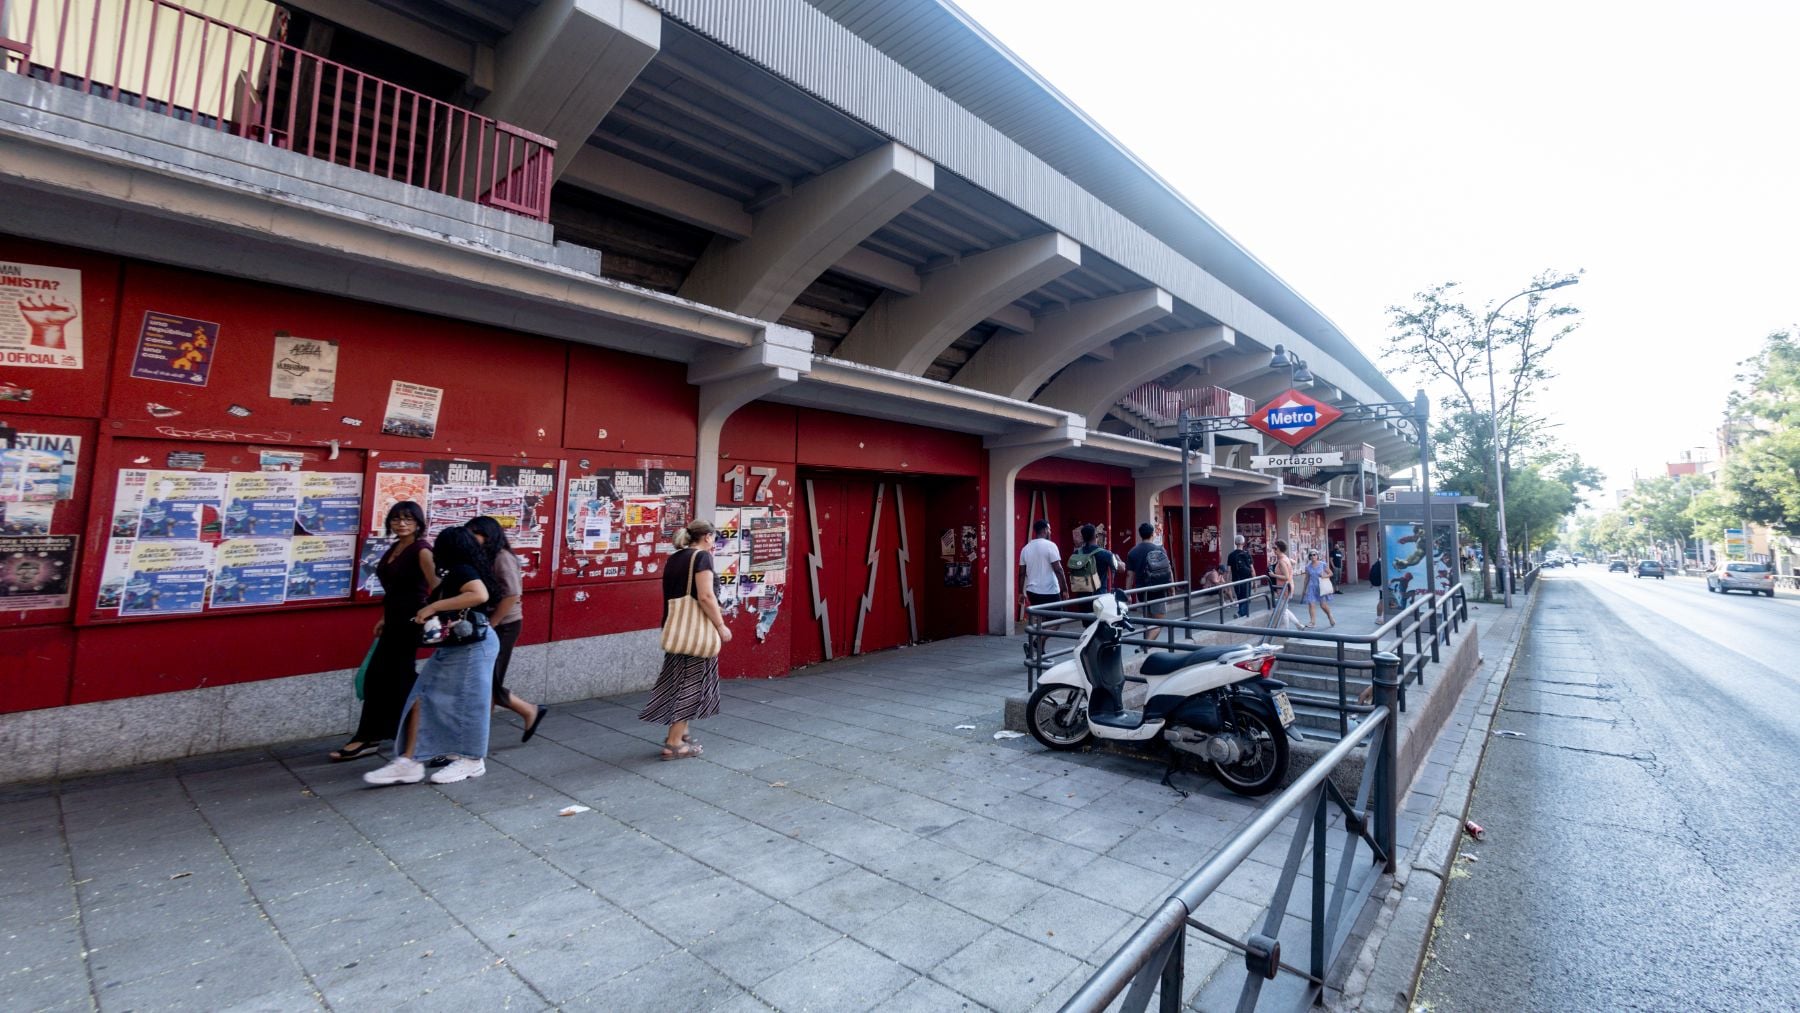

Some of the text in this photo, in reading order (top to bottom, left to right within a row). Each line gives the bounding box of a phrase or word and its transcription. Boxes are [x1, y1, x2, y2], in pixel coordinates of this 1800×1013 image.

[8, 352, 58, 364] OFICIAL
[1271, 412, 1313, 425] Metro
[1269, 456, 1323, 466] Portazgo
[448, 468, 487, 482] GUERRA
[518, 473, 553, 487] GUERRA
[615, 475, 643, 486] GUERRA
[664, 475, 689, 486] GUERRA
[724, 464, 777, 501] 17
[739, 573, 765, 586] paz
